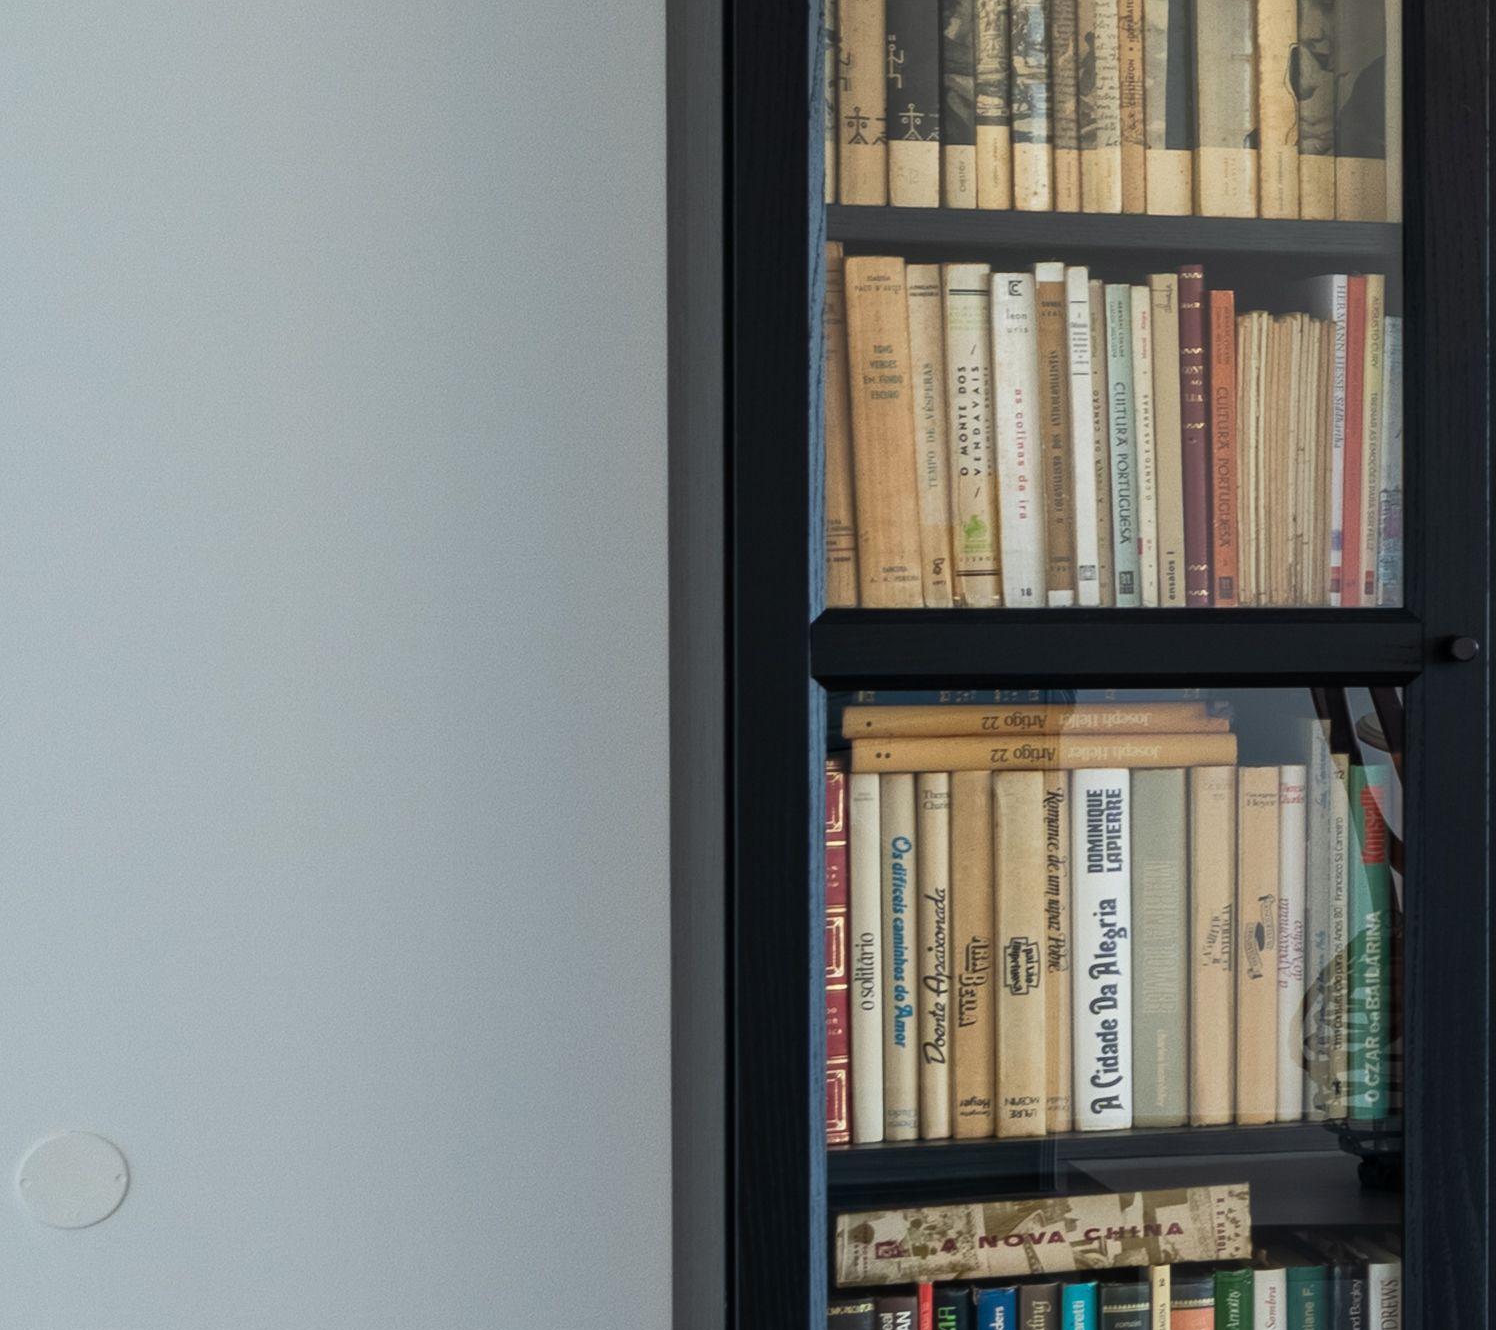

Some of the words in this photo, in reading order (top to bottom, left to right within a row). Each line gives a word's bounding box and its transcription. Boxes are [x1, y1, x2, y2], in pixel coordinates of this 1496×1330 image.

[1087, 788, 1104, 873] DOMINIQUE
[1106, 788, 1122, 872] LAPIERRE
[1088, 898, 1128, 979] Alegria
[1089, 983, 1118, 1017] Da
[1089, 1018, 1123, 1089] Cidade
[1090, 1094, 1125, 1115] A
[940, 1238, 958, 1253] A
[979, 1230, 1065, 1250] NOVA
[1084, 1222, 1185, 1242] CHINA
